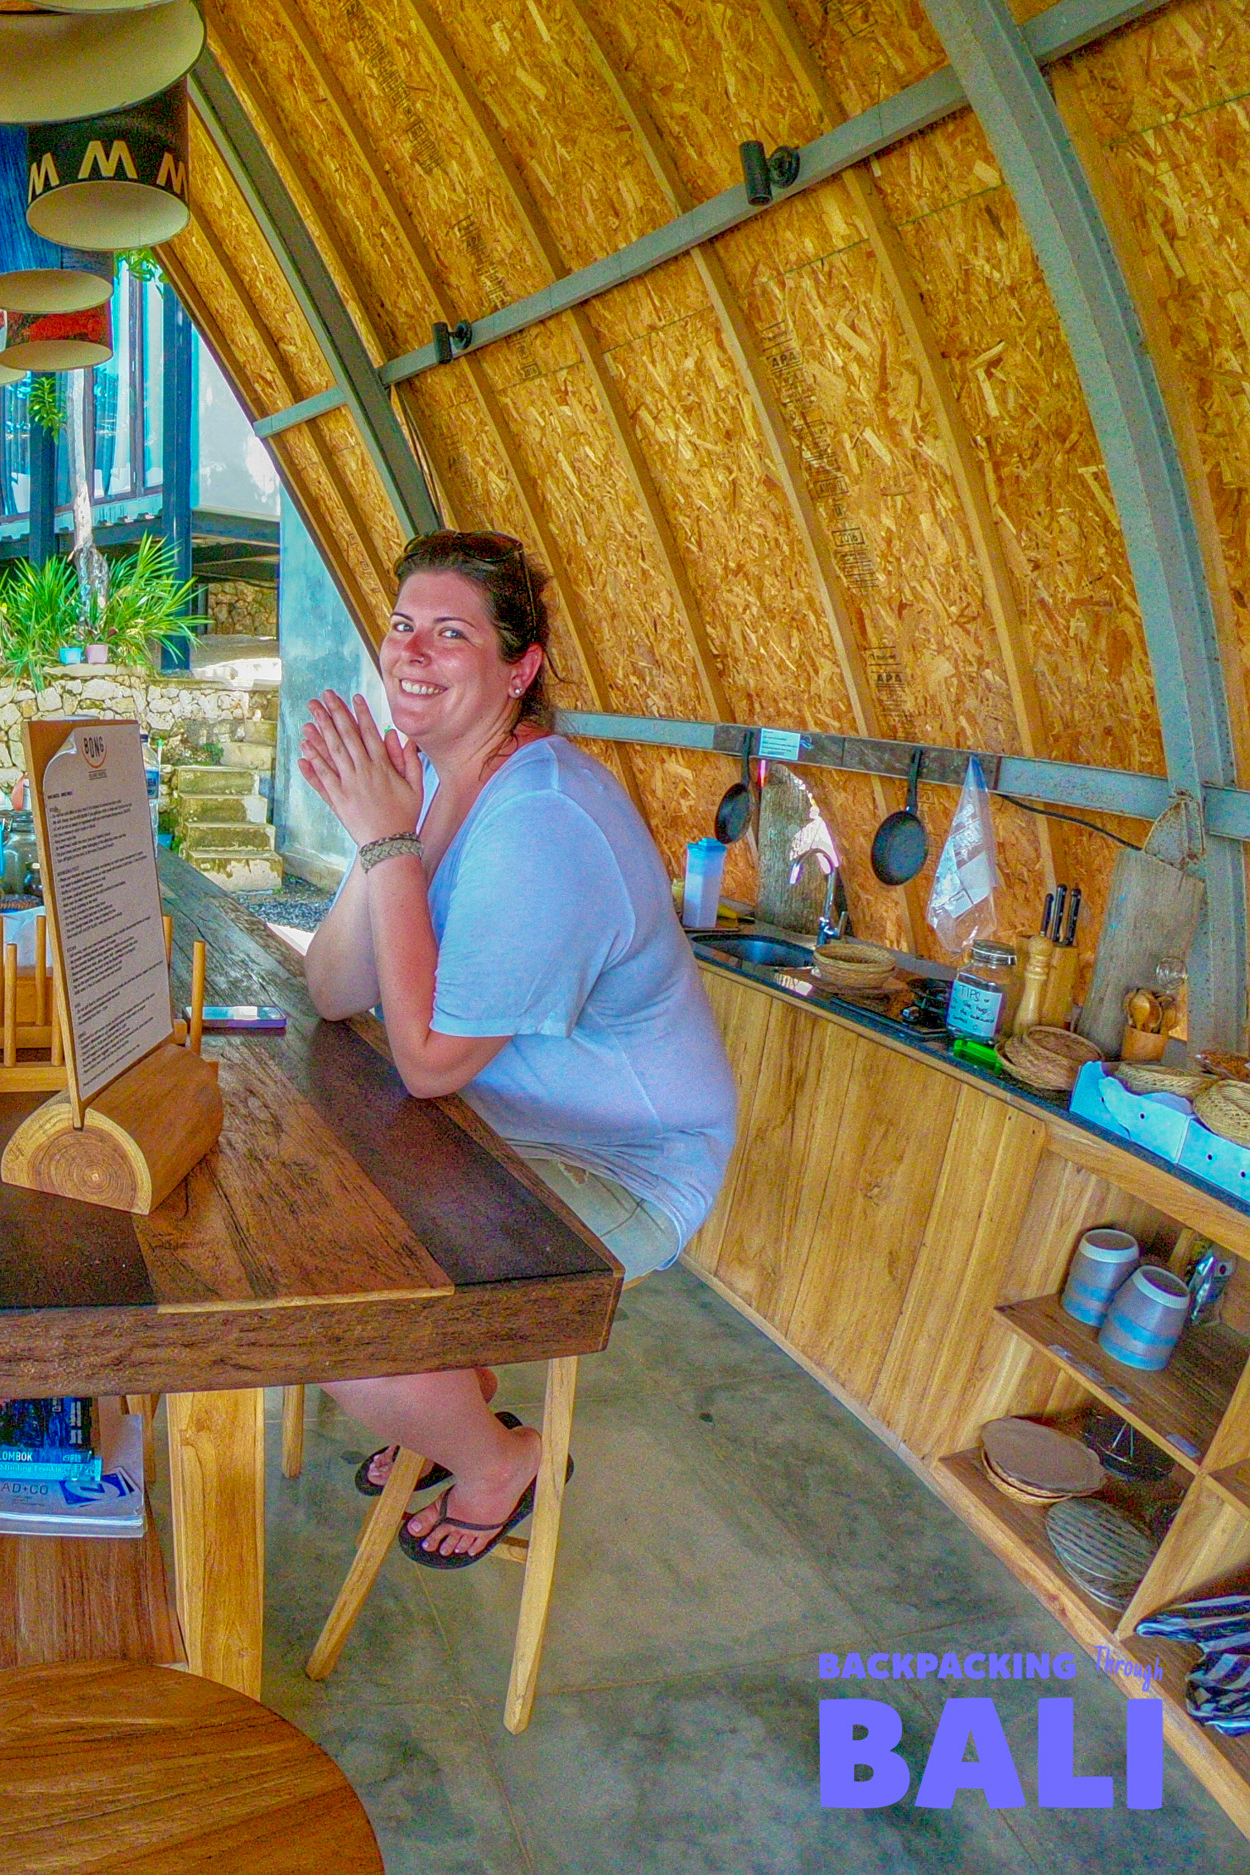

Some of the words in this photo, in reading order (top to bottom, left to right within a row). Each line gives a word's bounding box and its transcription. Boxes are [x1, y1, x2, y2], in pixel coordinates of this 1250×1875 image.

[772, 351, 797, 367] APA
[839, 532, 859, 543] 2016
[876, 673, 902, 683] APA
[83, 736, 104, 758] BONG
[958, 984, 980, 1002] TIPS
